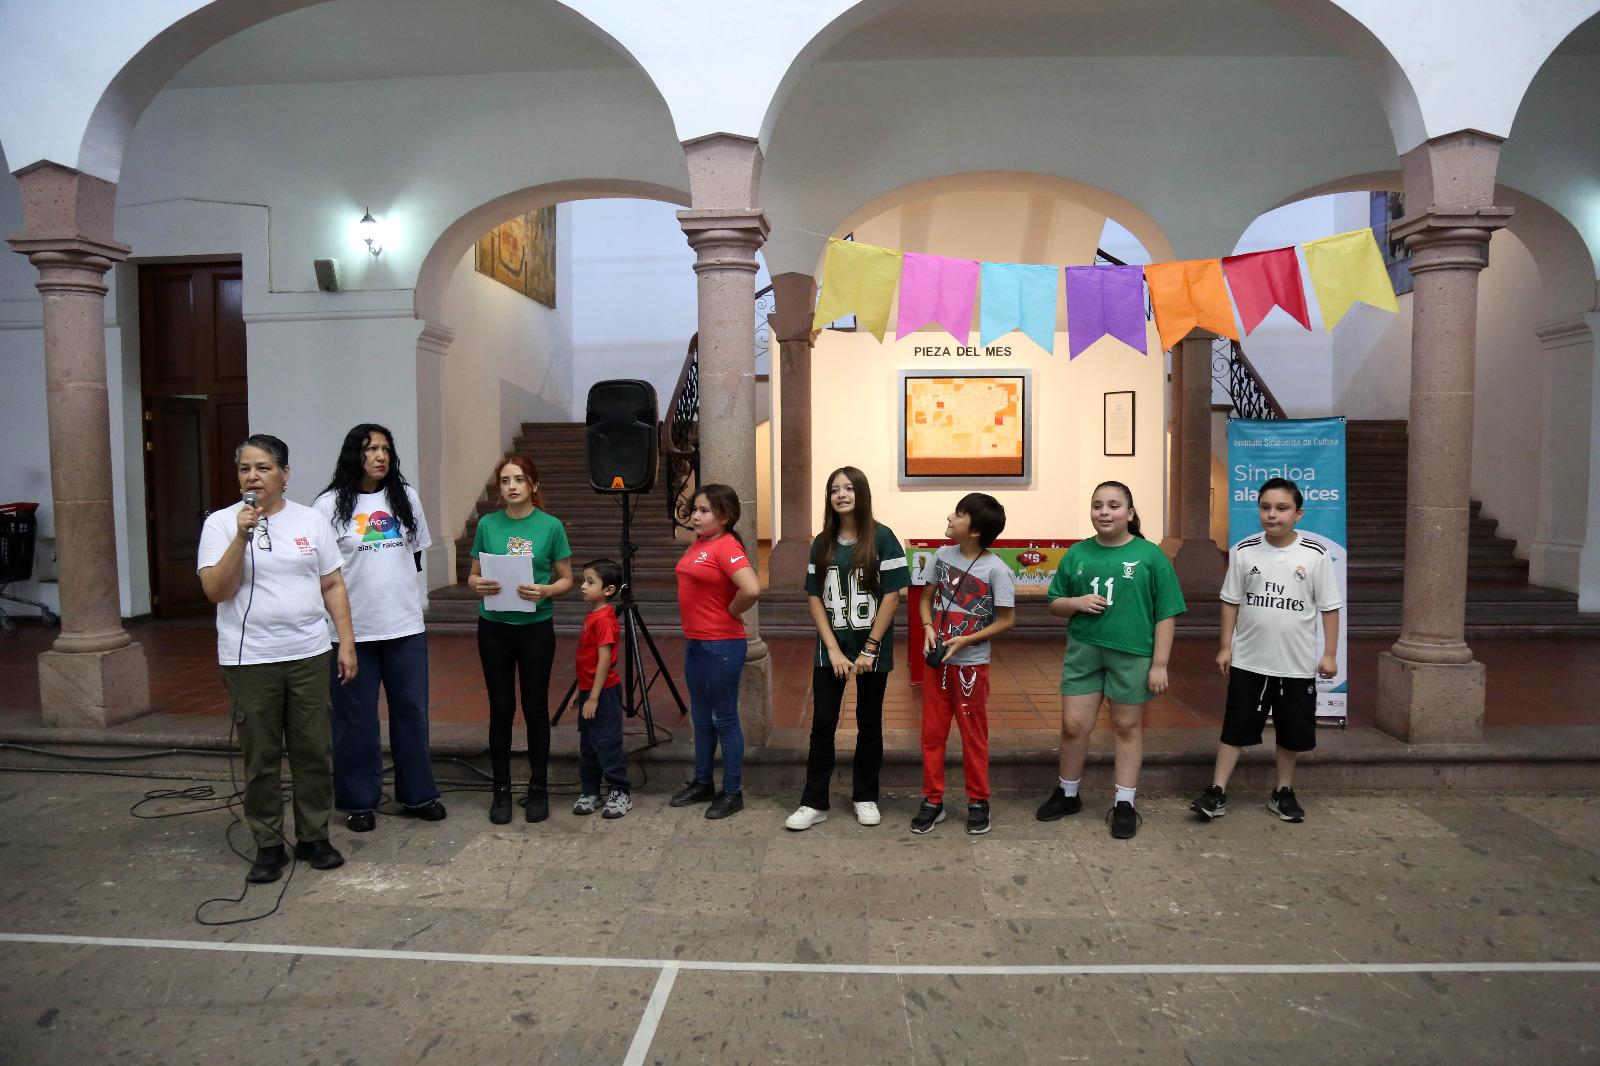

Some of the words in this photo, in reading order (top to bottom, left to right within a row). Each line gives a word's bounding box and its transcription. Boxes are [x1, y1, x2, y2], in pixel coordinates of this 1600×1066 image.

[914, 346, 951, 357] PIEZA
[956, 346, 981, 357] DEL
[985, 346, 1012, 357] MES
[1234, 438, 1262, 447] Instituto
[1264, 438, 1301, 447] Sinaloense
[1303, 438, 1312, 446] de
[1313, 437, 1339, 446] Cultura
[1234, 464, 1315, 481] Sinaloa
[1234, 487, 1259, 502] ala
[1301, 486, 1340, 501] íces
[1090, 576, 1114, 606] 11
[1265, 581, 1285, 595] Fly
[823, 566, 878, 630] 46
[1246, 592, 1305, 612] Emirates
